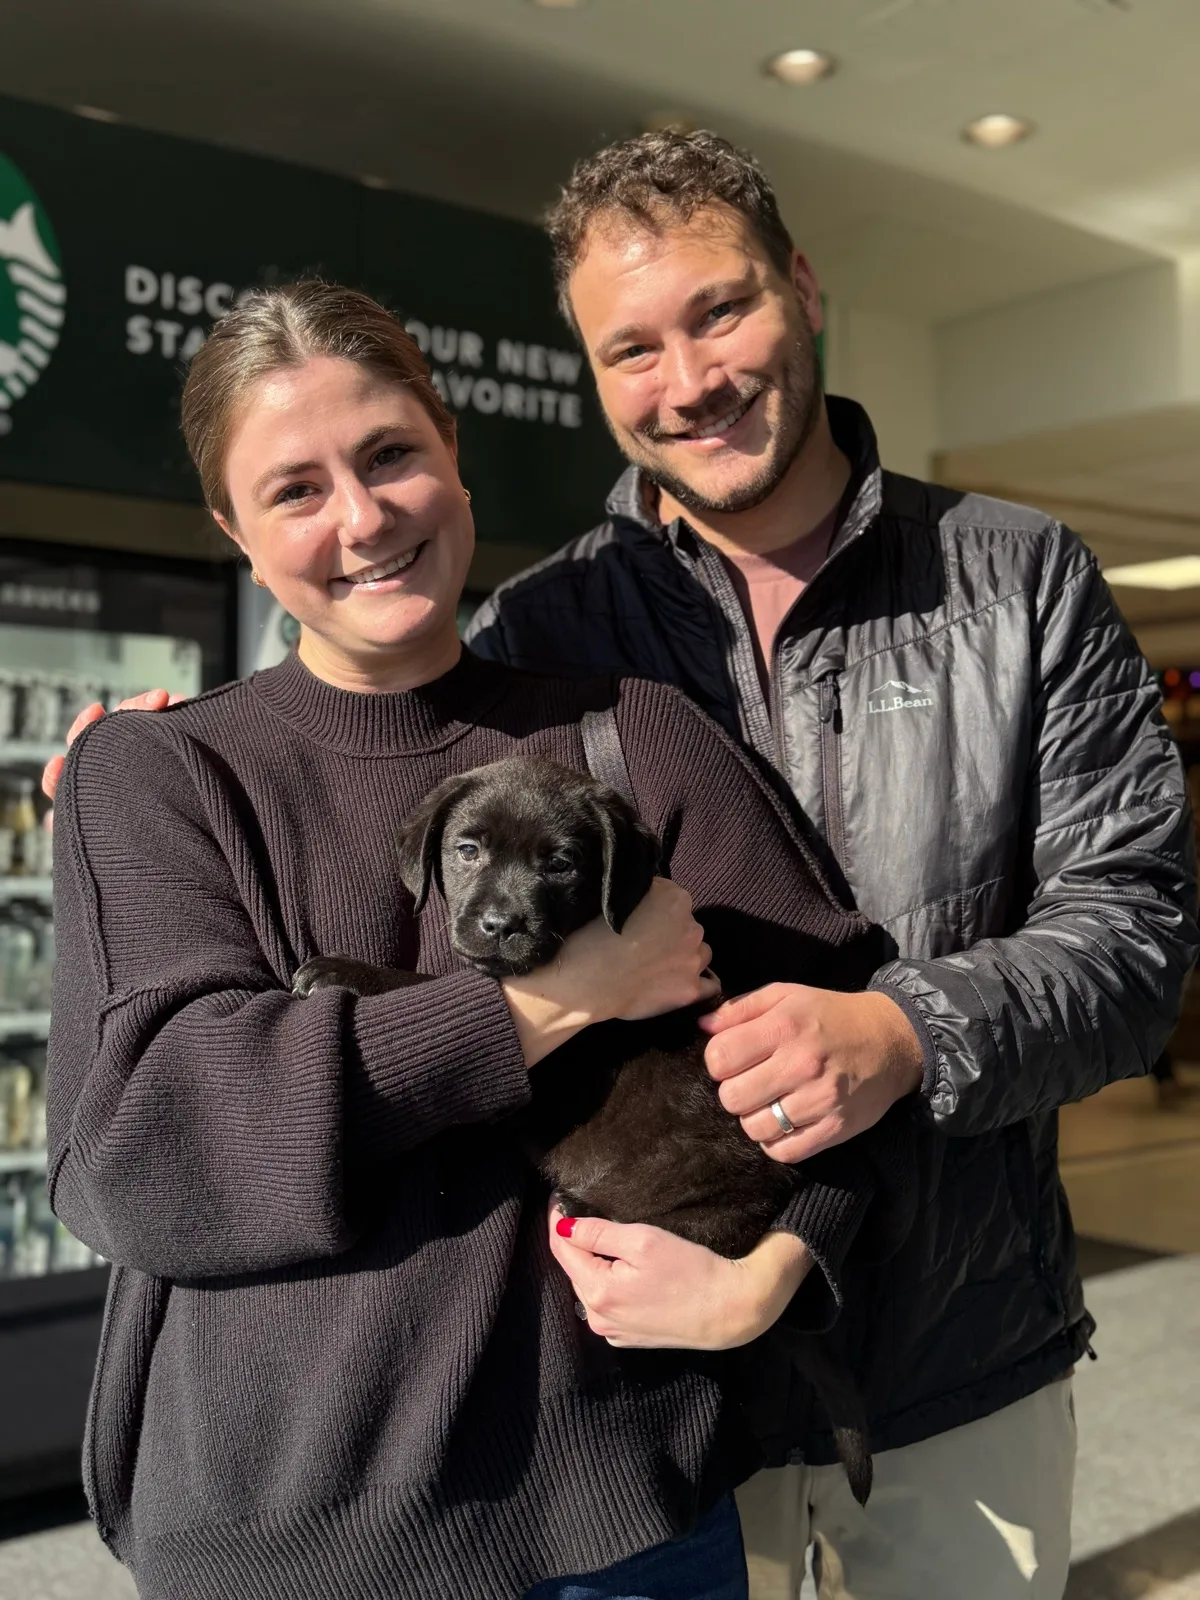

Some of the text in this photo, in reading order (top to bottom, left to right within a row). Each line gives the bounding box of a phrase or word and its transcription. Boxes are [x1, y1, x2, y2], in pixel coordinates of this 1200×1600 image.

[125, 264, 582, 386] DISC OUR NEW
[126, 314, 582, 428] STA AVORITE
